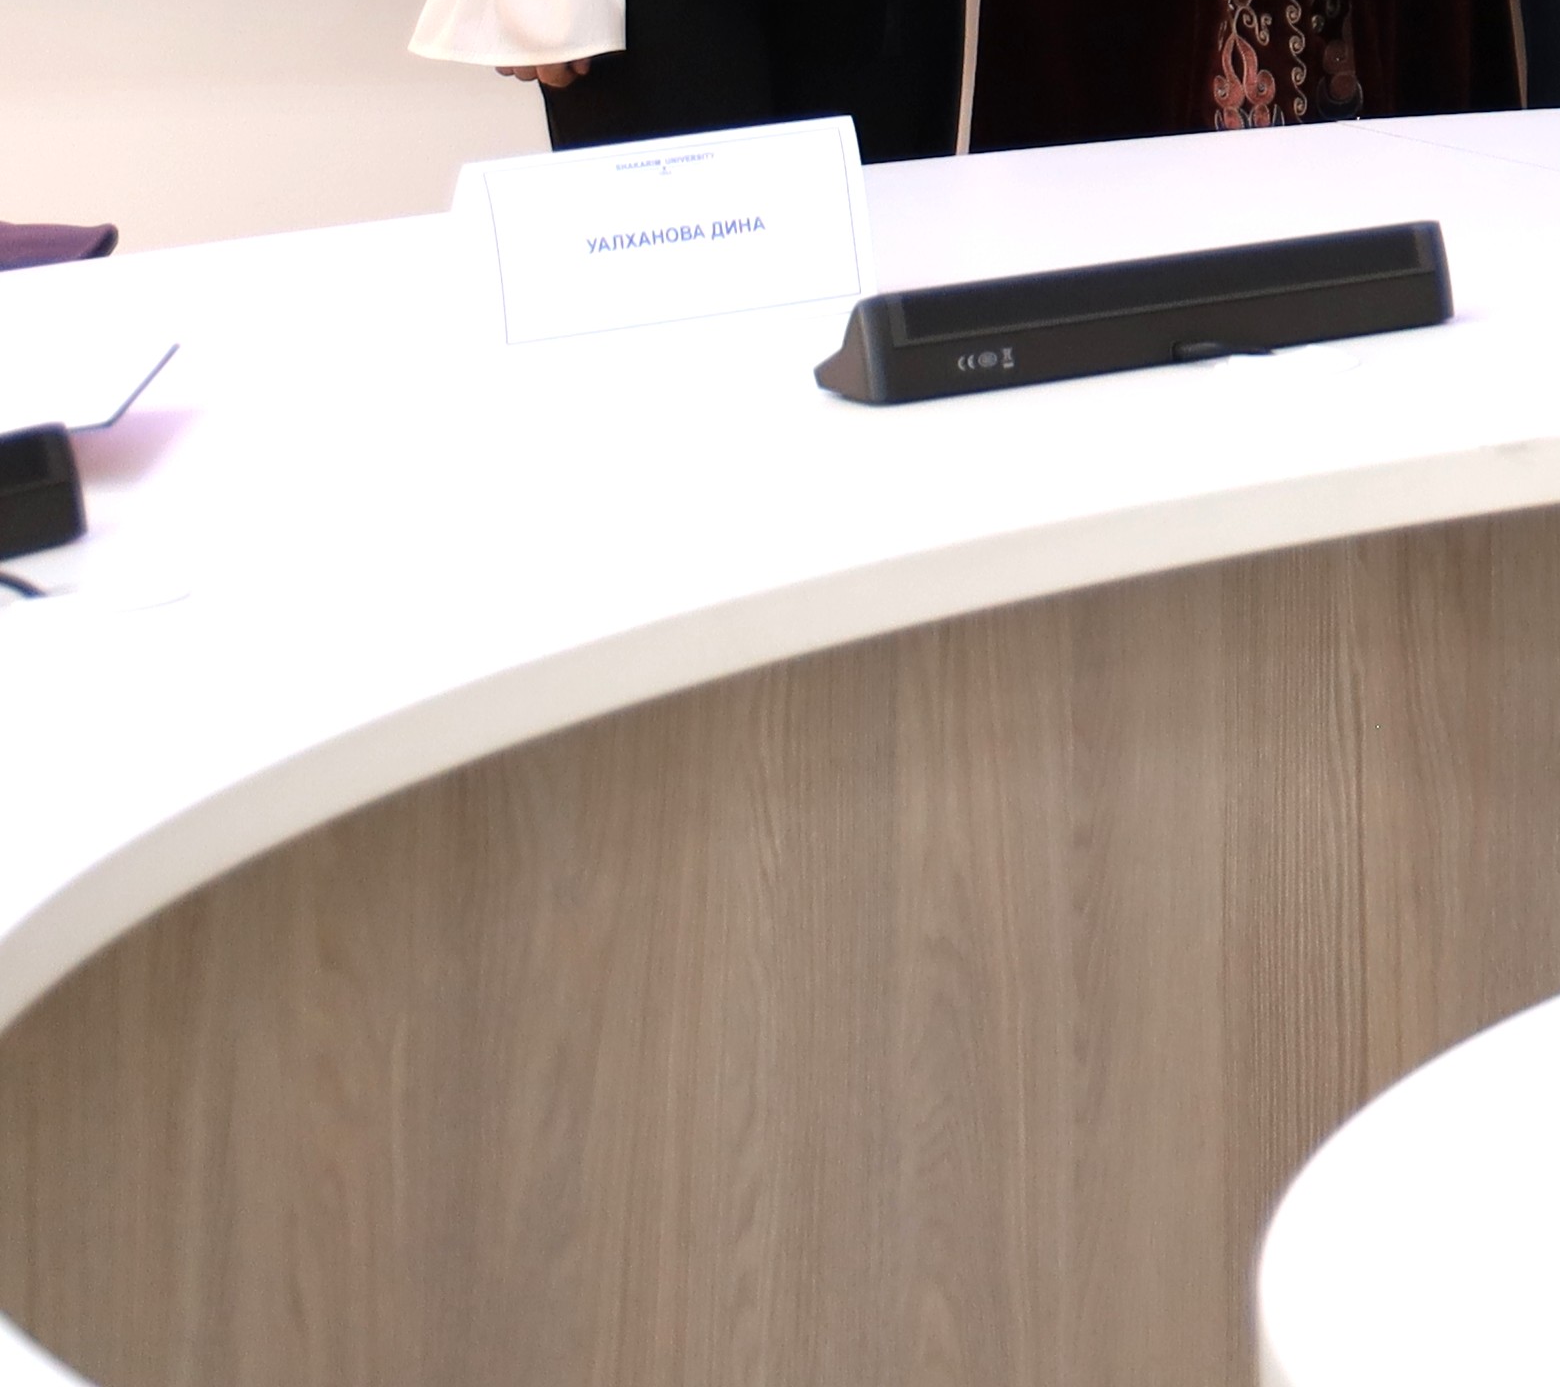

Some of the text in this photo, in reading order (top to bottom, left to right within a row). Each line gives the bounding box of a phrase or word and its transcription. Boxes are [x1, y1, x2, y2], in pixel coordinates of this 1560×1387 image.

[616, 152, 715, 171] SHAKARIM UNIVERSITY
[586, 215, 766, 254] УАЛХАНОВА ДИНА
